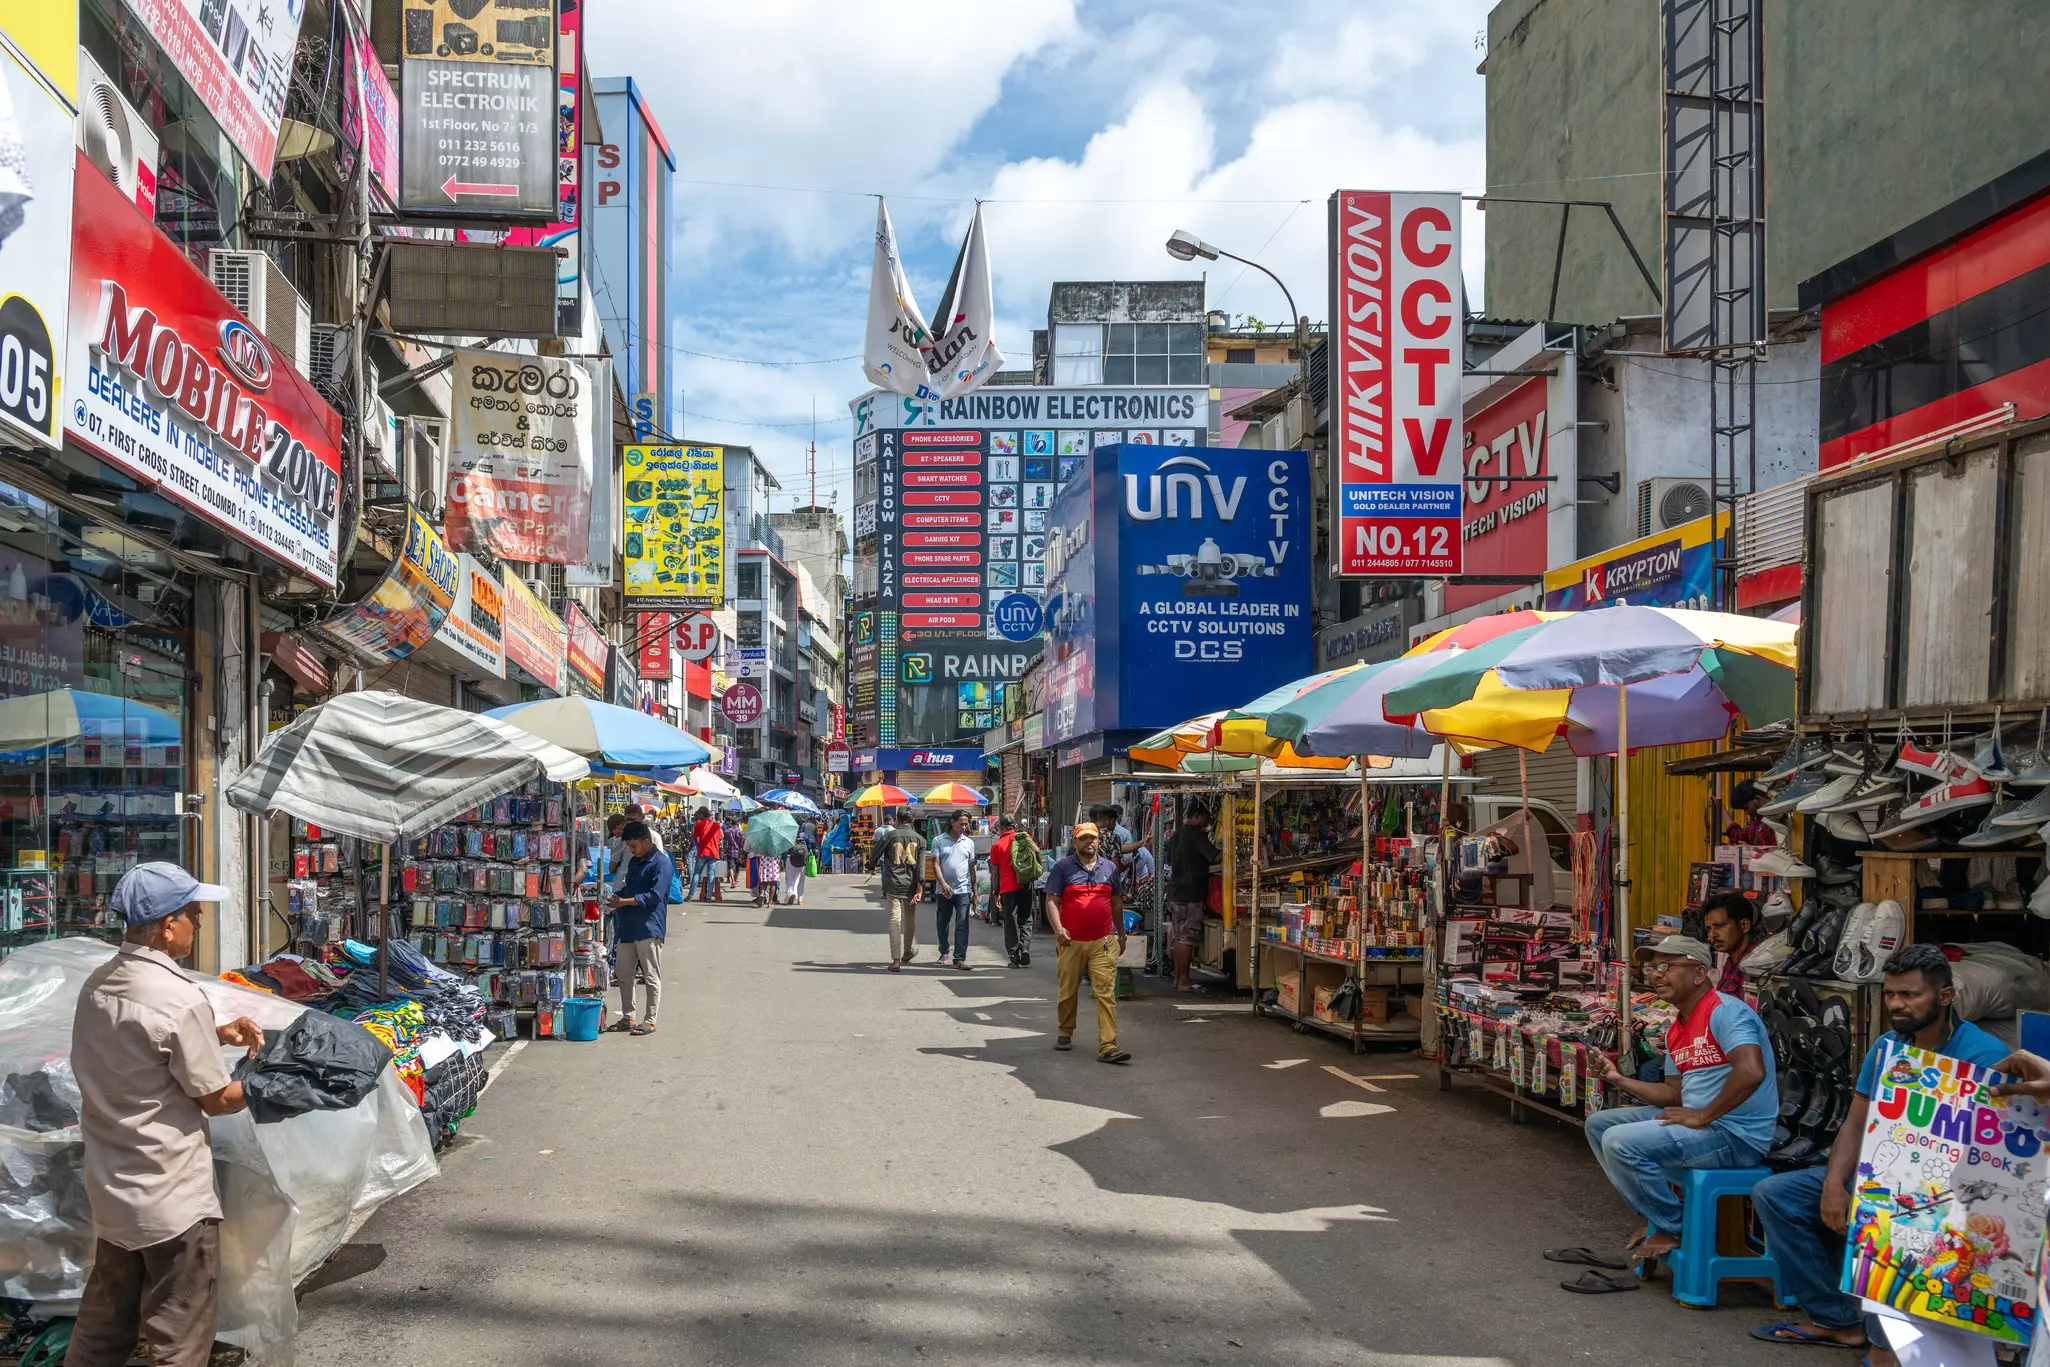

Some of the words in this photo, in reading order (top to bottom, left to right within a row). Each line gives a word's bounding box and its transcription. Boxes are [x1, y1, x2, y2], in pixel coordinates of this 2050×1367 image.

[191, 35, 212, 68] CROSS
[186, 52, 204, 84] MOB
[428, 70, 531, 90] SPECTRUM
[420, 91, 539, 112] ELECTRONIK
[421, 118, 440, 131] 1st
[443, 118, 480, 132] Floor,
[481, 120, 500, 132] No
[518, 121, 538, 134] 1/3
[439, 139, 461, 150] 011
[465, 140, 487, 152] 232
[490, 141, 520, 153] 5616
[439, 155, 469, 167] 0772
[471, 156, 487, 168] 49
[490, 156, 520, 169] 4929
[1347, 205, 1383, 476] HIKVISION
[1399, 206, 1453, 477] CCTV
[0, 333, 47, 422] 05
[97, 279, 268, 465] MOBILE
[264, 421, 339, 521] ZONE
[940, 396, 1041, 420] RAINBOW
[1046, 395, 1195, 420] ELECTRONICS
[516, 415, 531, 431] &
[88, 365, 162, 436] DEALERS
[166, 420, 180, 449] IN
[184, 433, 230, 482] MOBILE
[233, 464, 269, 510] PHONE
[271, 495, 331, 550] ACCESSORIES
[1463, 410, 1547, 504] CTV
[89, 412, 106, 442] 07,
[108, 423, 137, 453] FIRST
[139, 439, 168, 475] CROSS
[170, 463, 201, 499] STREET,
[202, 483, 237, 517] COLOMBO
[238, 507, 249, 527] 11.
[257, 519, 274, 542] 0112
[301, 547, 315, 567] 0777
[882, 433, 895, 523] RAINBOW
[450, 477, 590, 517] Camera
[1349, 490, 1407, 501] UNITECH
[1410, 490, 1455, 501] VISION
[1267, 460, 1289, 565] CCTV
[1463, 511, 1496, 542] TECH
[1500, 487, 1547, 525] VISION
[523, 519, 570, 538] Parts
[1356, 526, 1449, 556] NO.12
[405, 517, 427, 571] SEA
[426, 540, 458, 600] SHORE
[501, 541, 557, 558] ervice
[882, 534, 894, 597] PLAZA
[1351, 559, 1365, 567] 011
[1367, 559, 1400, 568] 2444805
[1405, 559, 1419, 567] 077
[1421, 559, 1453, 568] 7145510
[1605, 548, 1681, 589] KRYPTON
[904, 576, 941, 584] ELECTRICAL
[1613, 583, 1641, 594] RELIABILITY
[1653, 574, 1671, 584] SAFETY
[1139, 602, 1151, 614] A
[1155, 602, 1217, 616] GLOBAL
[1220, 602, 1280, 617] LEADER
[1284, 604, 1300, 617] IN
[675, 623, 716, 650] S.P
[1002, 623, 1035, 632] CCTV
[1147, 620, 1193, 633] CCTV
[1198, 621, 1286, 635] SOLUTIONS
[1175, 640, 1243, 659] DCS
[944, 655, 1026, 677] RAINB
[726, 695, 757, 709] MM
[892, 842, 918, 865] M
[1692, 1053, 1722, 1066] JEANS
[1694, 1044, 1719, 1057] BASIC
[1919, 1066, 1998, 1105] SUPE
[1878, 1087, 2042, 1159] JUMBO
[1894, 1127, 1961, 1164] Coloring
[1967, 1145, 2013, 1173] Book
[1913, 1274, 2032, 1318] COLORING
[1927, 1296, 2006, 1331] PAGES
